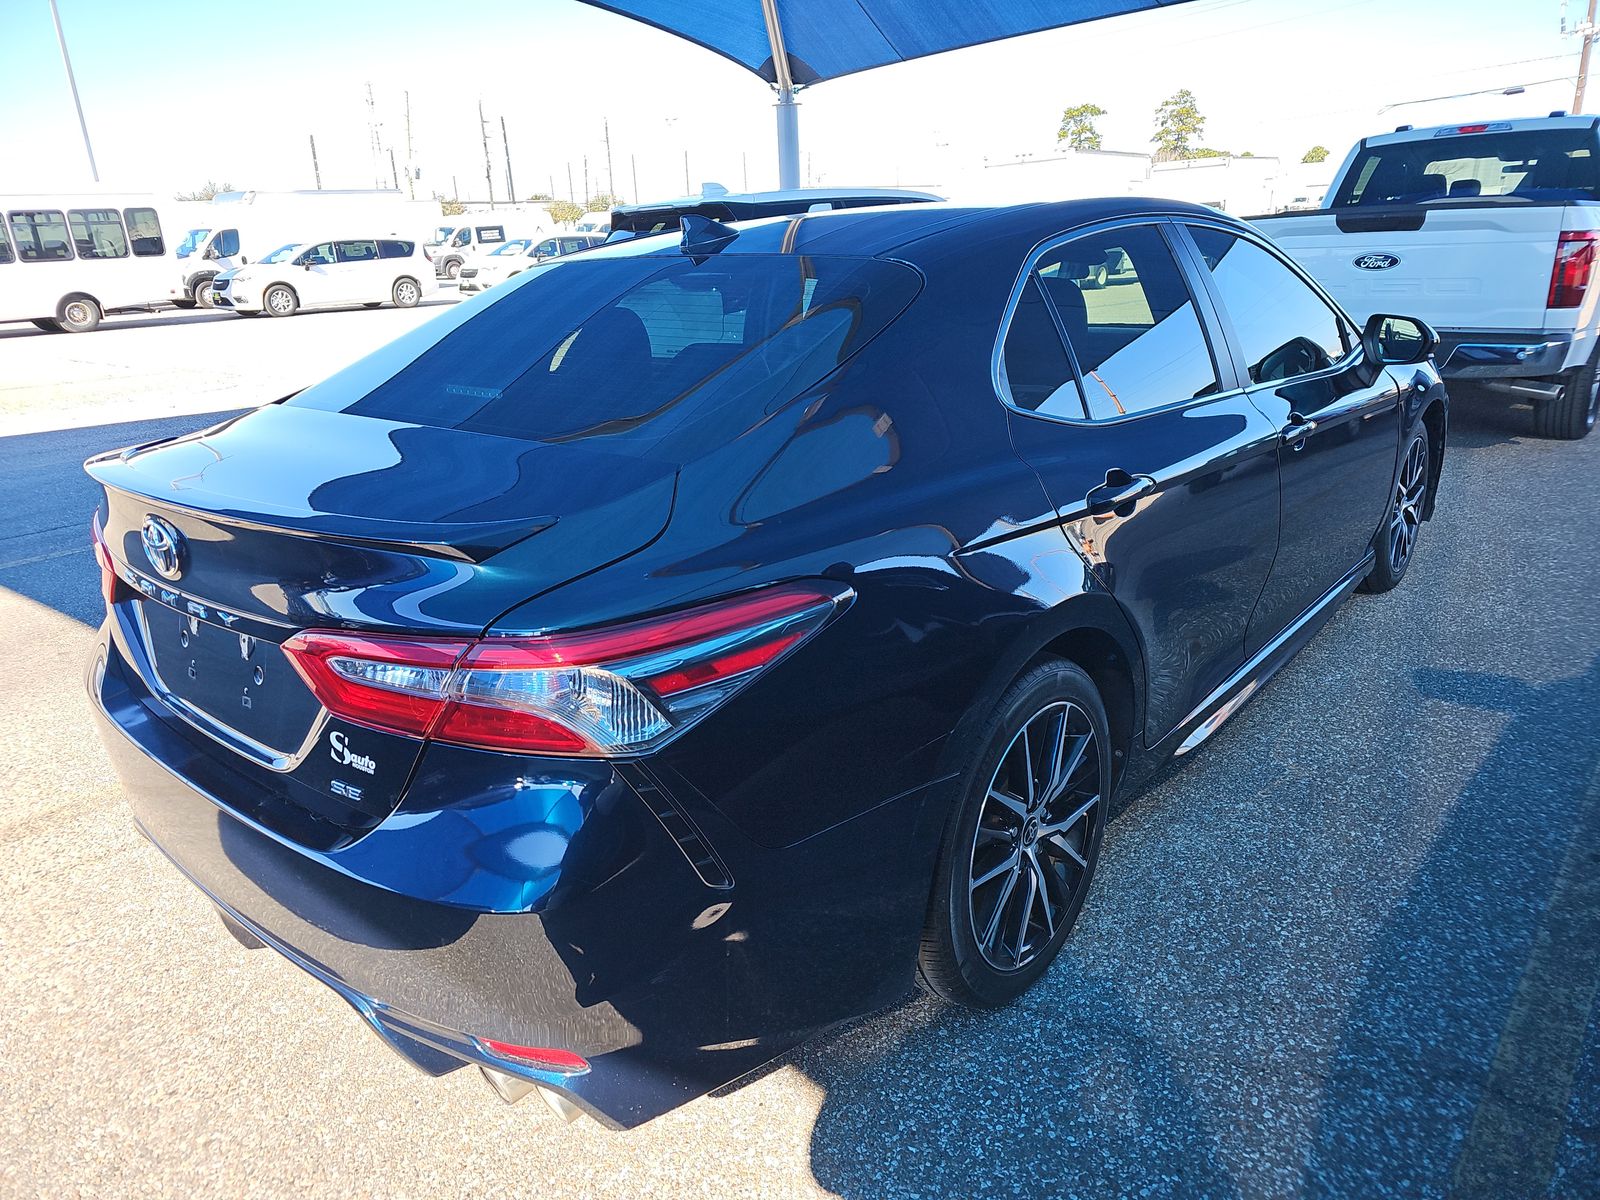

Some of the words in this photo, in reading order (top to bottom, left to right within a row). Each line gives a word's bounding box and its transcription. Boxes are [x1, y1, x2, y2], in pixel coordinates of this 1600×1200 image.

[1360, 254, 1392, 269] Ford
[1319, 277, 1482, 297] -150
[124, 568, 239, 627] CAMRY
[330, 779, 362, 801] SE
